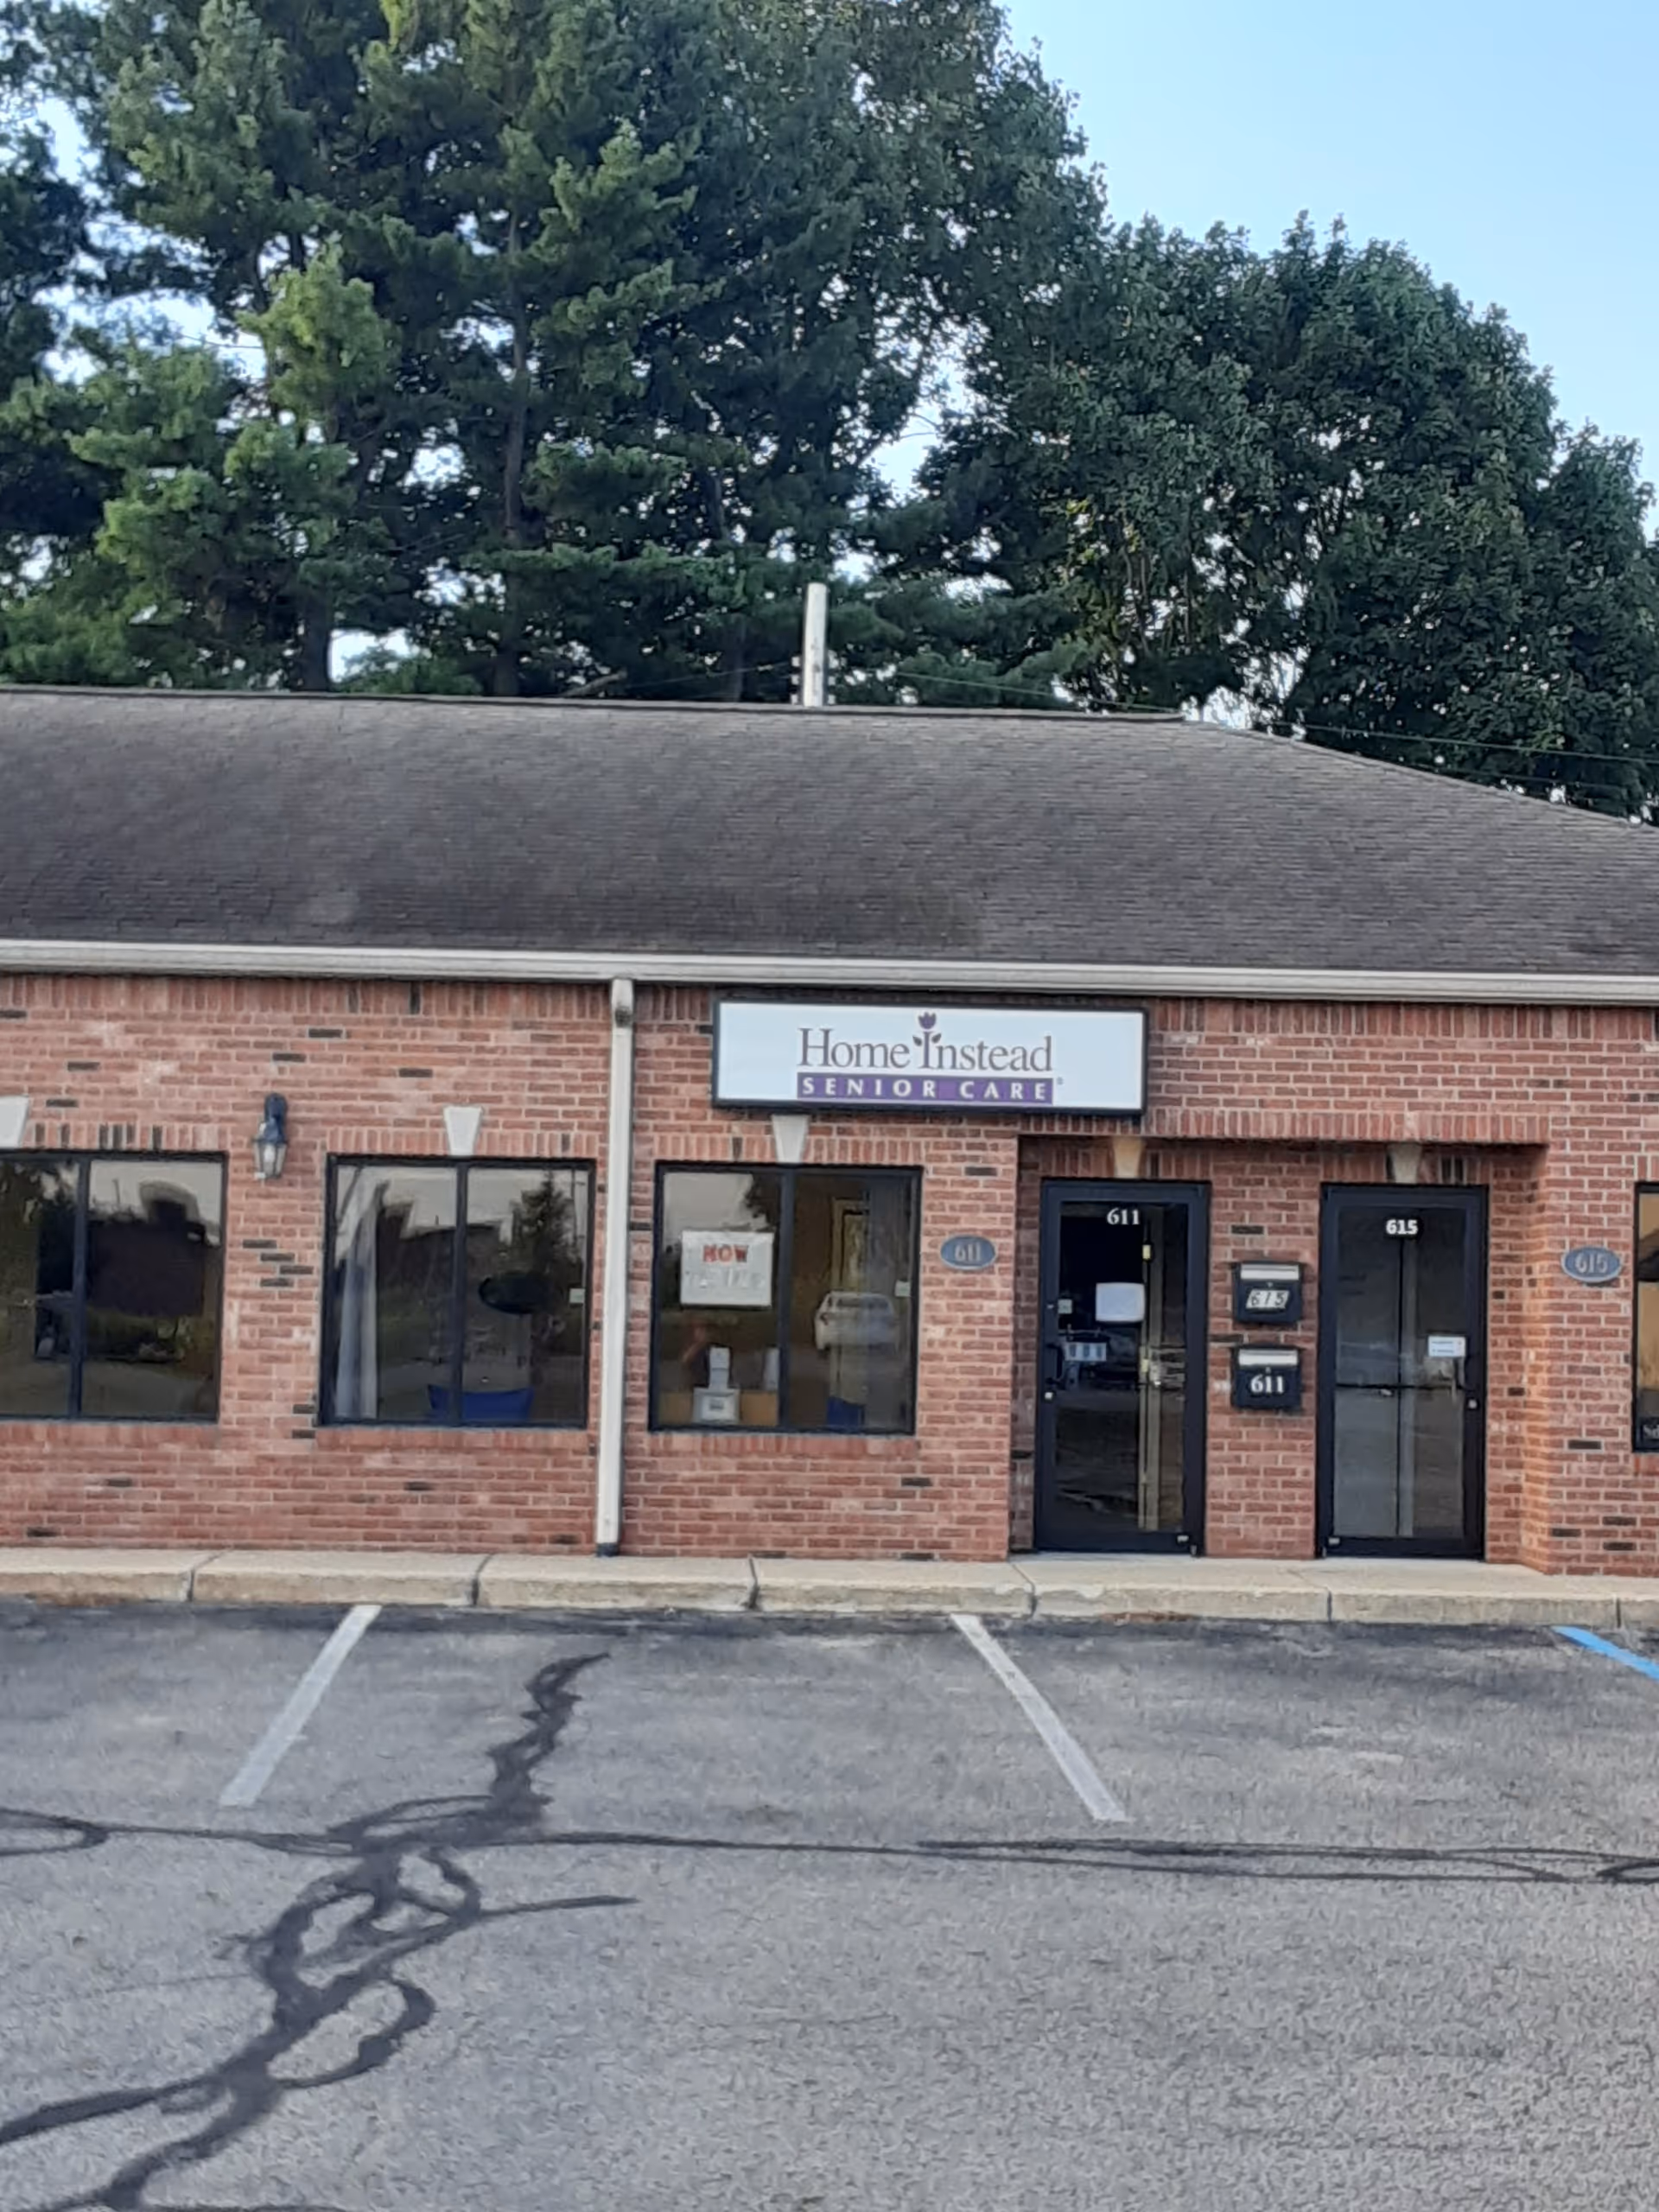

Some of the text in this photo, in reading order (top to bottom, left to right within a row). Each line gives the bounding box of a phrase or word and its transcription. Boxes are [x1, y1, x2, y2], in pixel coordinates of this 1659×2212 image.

[798, 1027, 1052, 1072] Home Instead
[802, 1077, 937, 1098] SENIOR
[961, 1080, 1047, 1101] CARE
[1107, 1208, 1141, 1225] 611
[1385, 1219, 1419, 1236] 615
[954, 1243, 982, 1262] 611
[1574, 1253, 1609, 1274] 615
[1249, 1290, 1287, 1306] 615
[1249, 1376, 1284, 1394] 611
